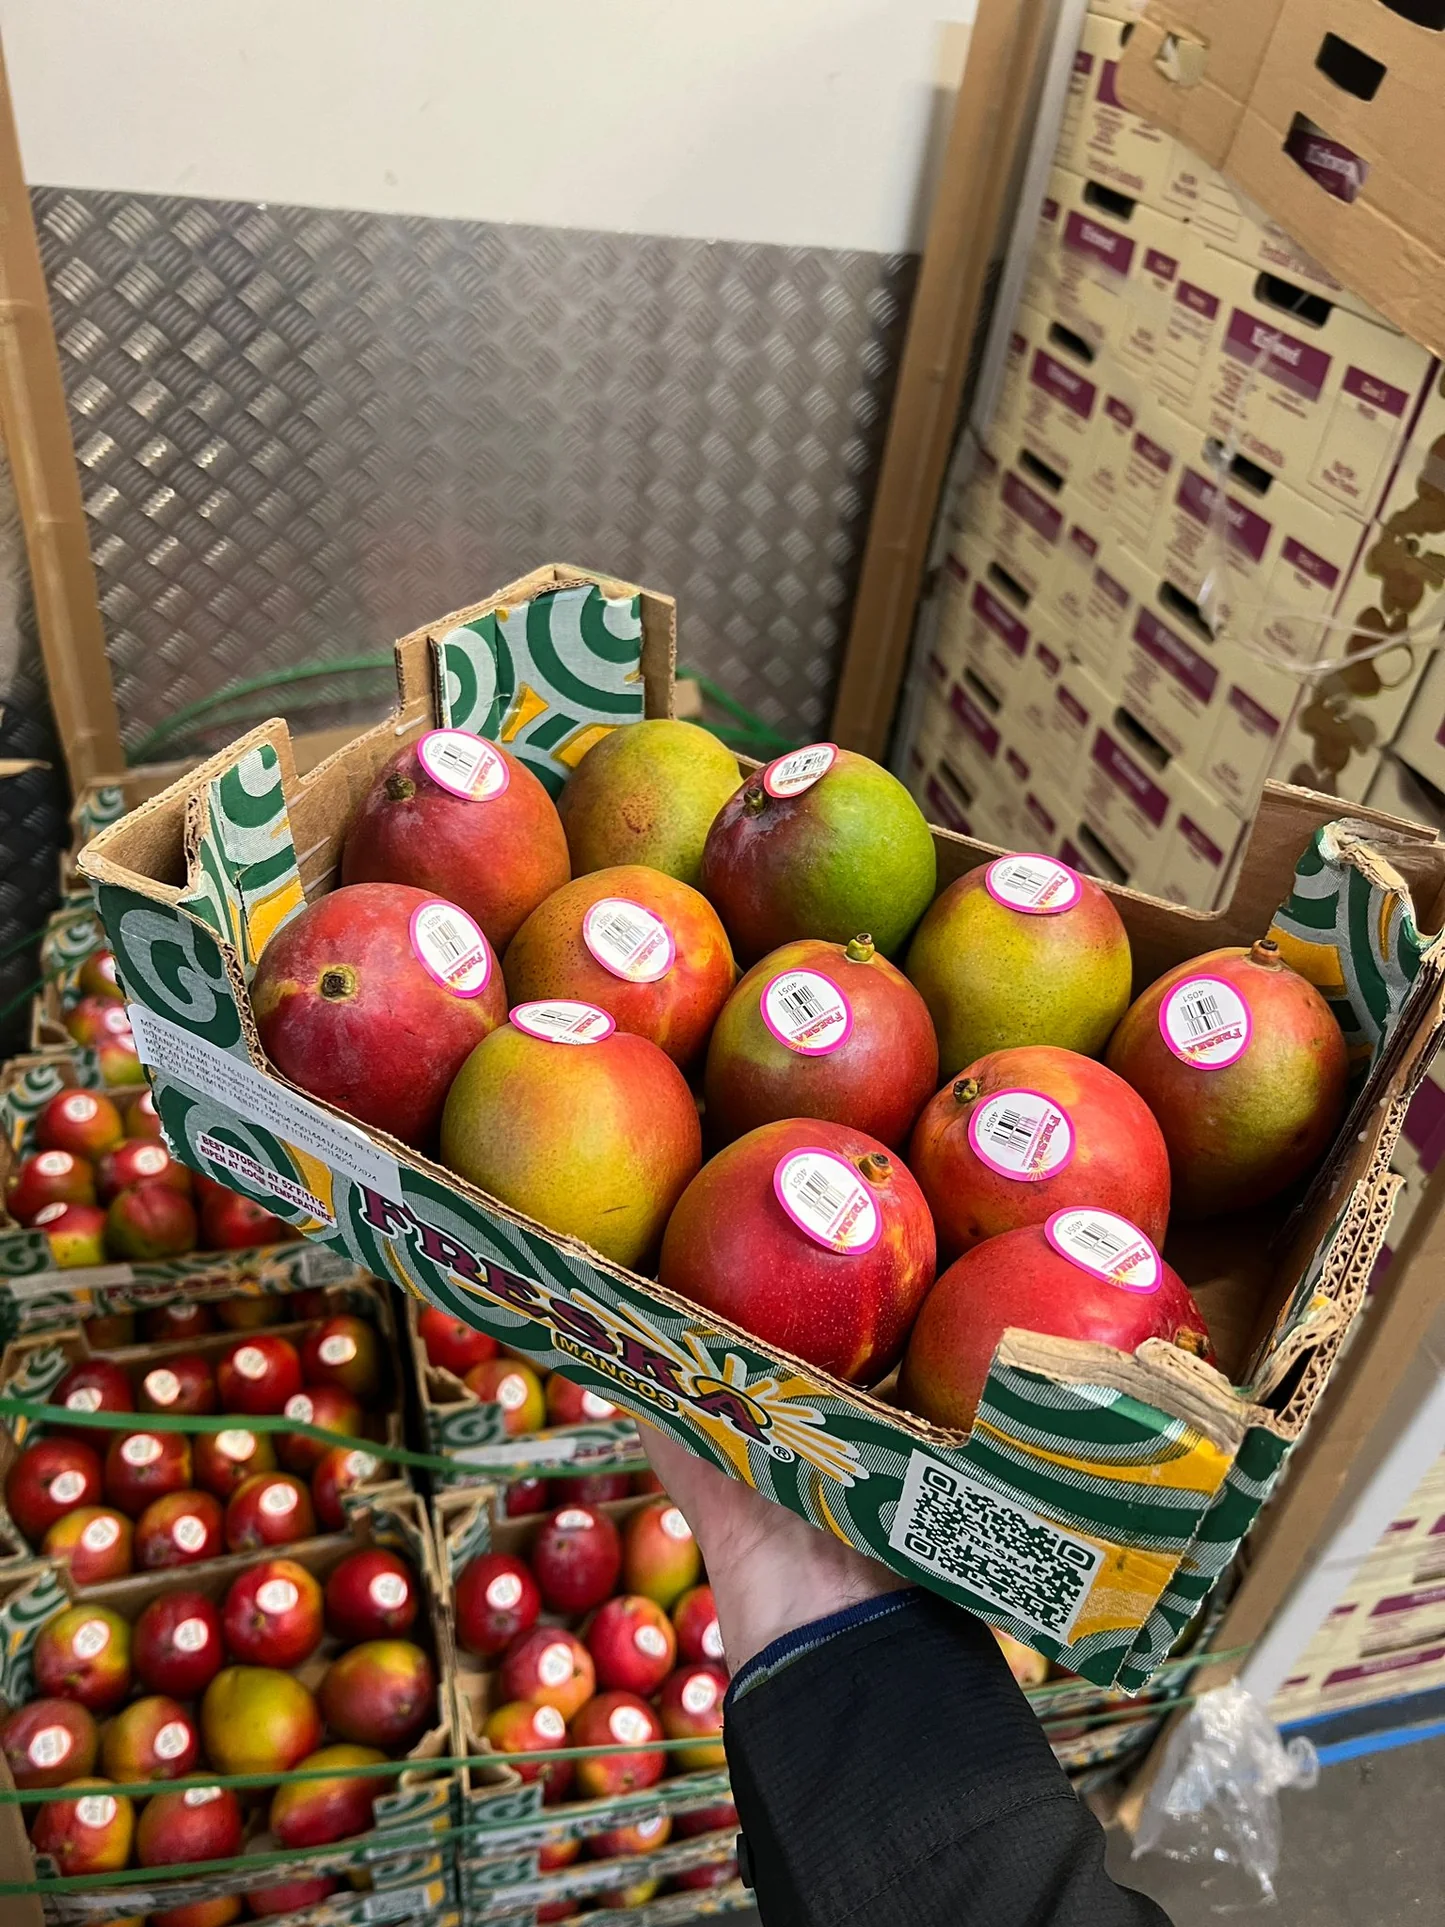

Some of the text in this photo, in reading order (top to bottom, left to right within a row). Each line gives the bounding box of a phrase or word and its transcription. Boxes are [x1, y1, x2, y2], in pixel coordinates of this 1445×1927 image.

[1033, 874, 1068, 905] FRESKA
[424, 915, 442, 929] 4051
[446, 951, 484, 983] FRESKA
[778, 982, 797, 996] 4051
[1182, 990, 1204, 1002] 4051
[139, 1017, 175, 1042] MEXICAN
[791, 1011, 844, 1042] FRESKA
[1183, 1028, 1242, 1053] FRESKA
[984, 1112, 998, 1133] 4051
[1027, 1114, 1061, 1170] FRESKA
[201, 1134, 225, 1154] BEST
[228, 1148, 264, 1175] STORED
[267, 1170, 279, 1184] AT
[200, 1144, 226, 1164] RIPEN
[228, 1158, 238, 1171] AT
[268, 1181, 333, 1224] TEMPERATURE
[790, 1168, 807, 1189] 4051
[832, 1195, 869, 1241] FRESKA
[1064, 1220, 1083, 1236] 4051
[1107, 1247, 1151, 1277] FRESKA
[362, 1182, 771, 1445] FRESKA
[558, 1335, 678, 1411] MANGOS
[958, 1524, 1033, 1576] FRESKA
